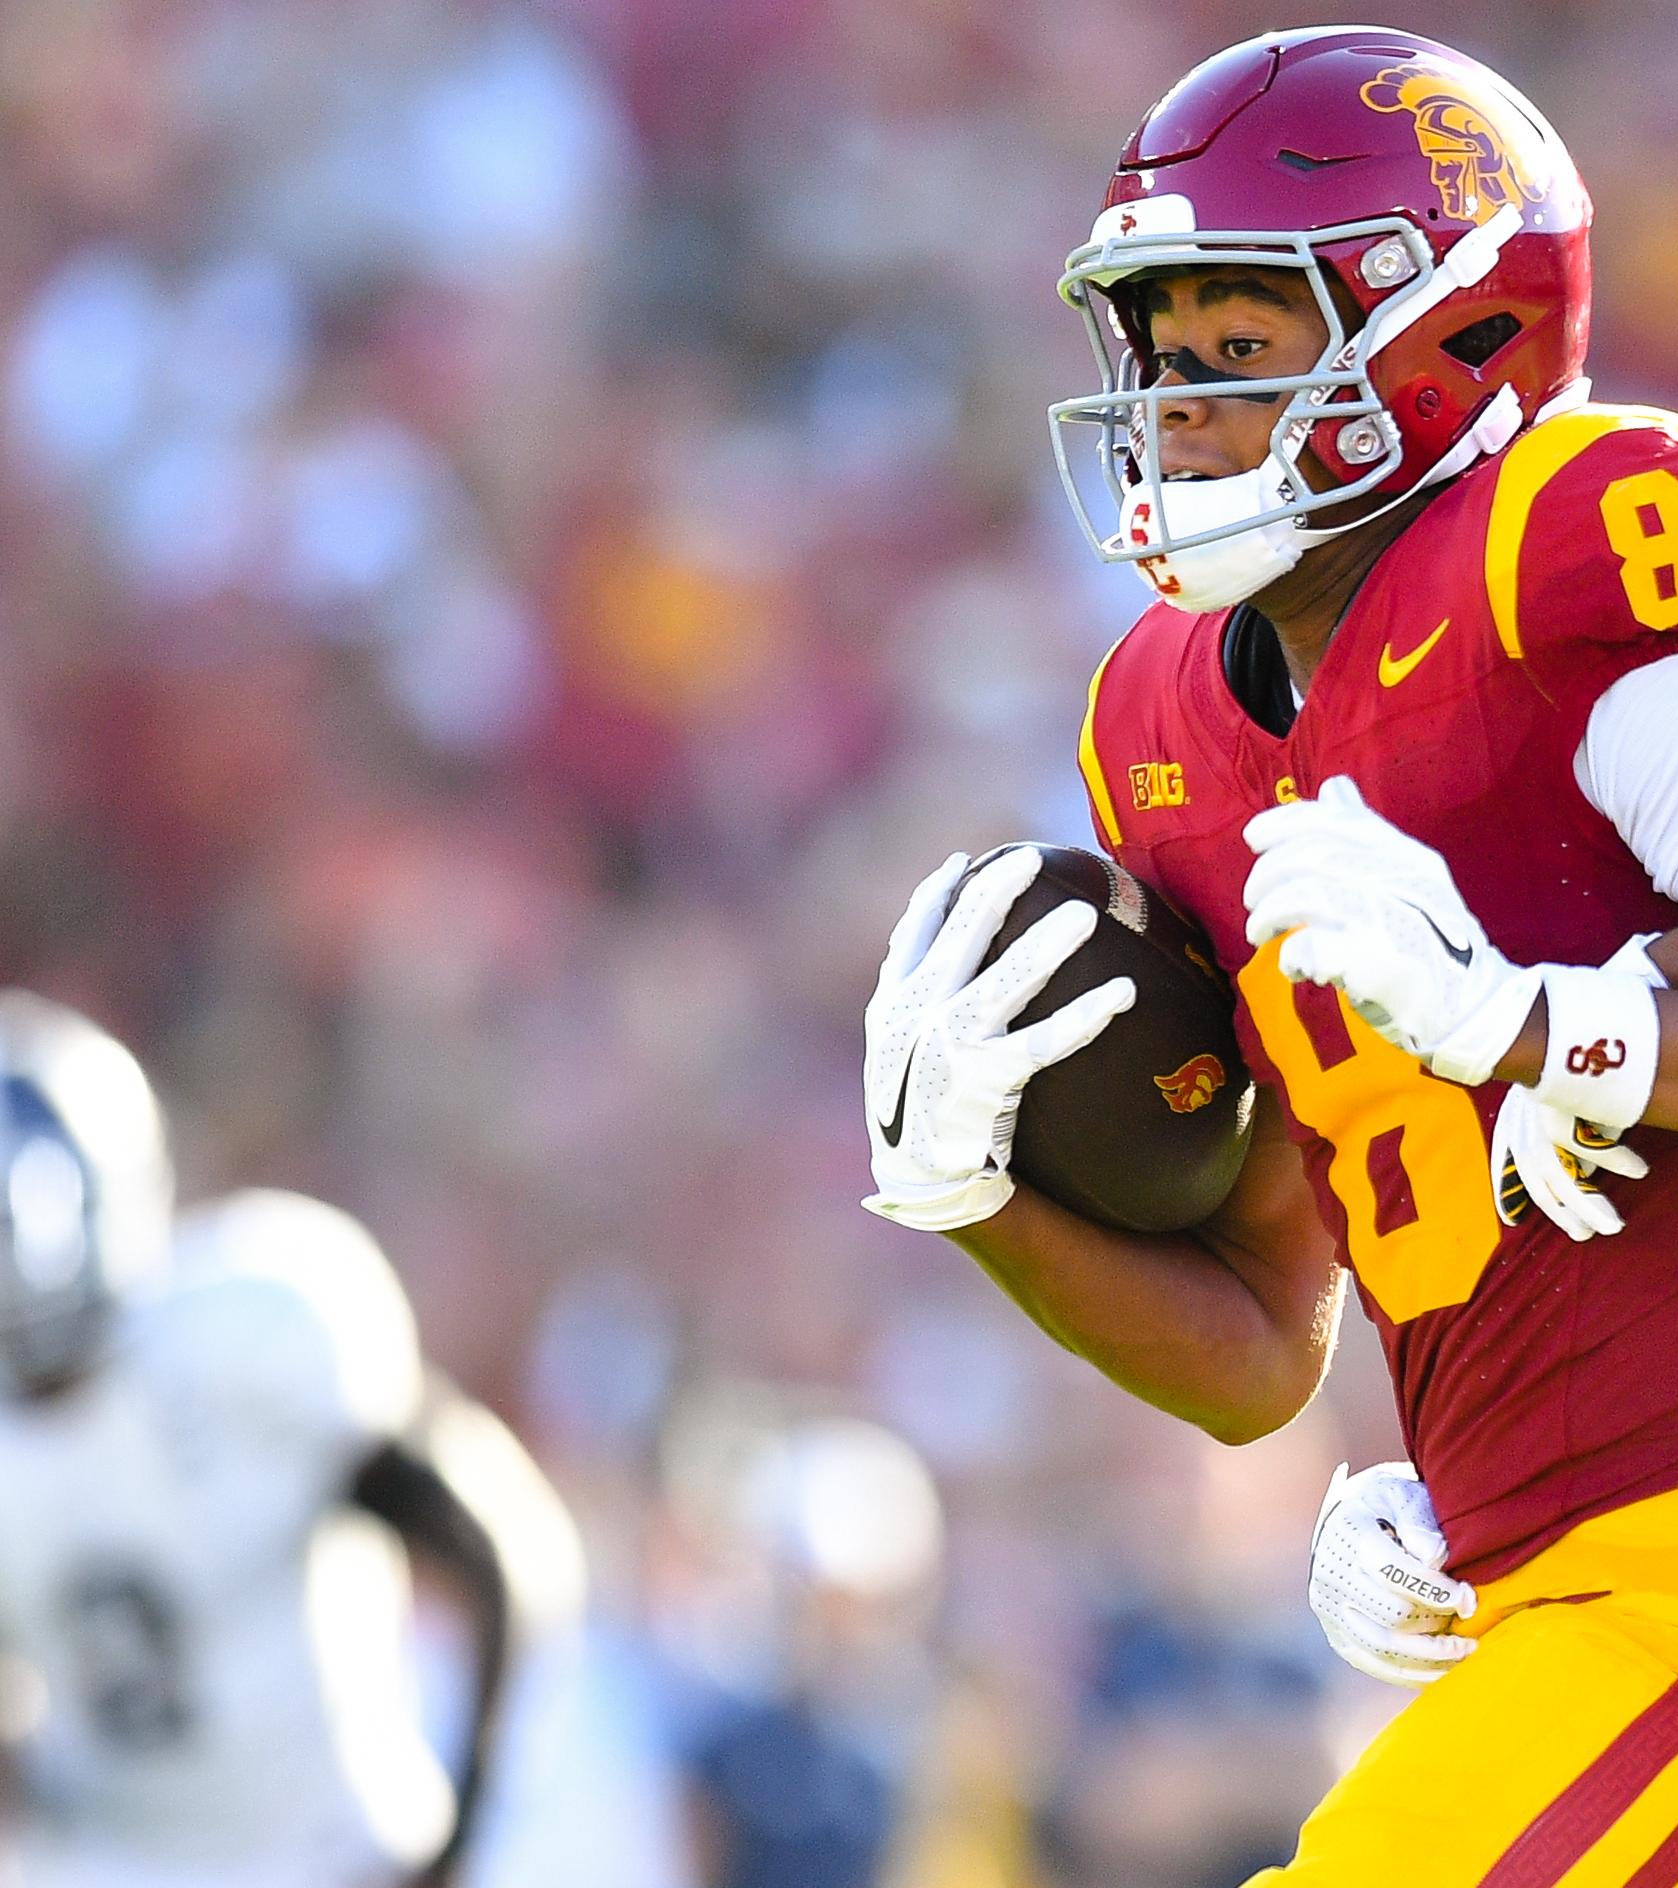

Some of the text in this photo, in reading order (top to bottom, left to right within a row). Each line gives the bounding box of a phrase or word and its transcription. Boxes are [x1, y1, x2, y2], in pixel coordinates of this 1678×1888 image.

[1566, 1038, 1626, 1077] SC
[1238, 926, 1501, 1325] 8
[1379, 1563, 1451, 1604] ADIZERO
